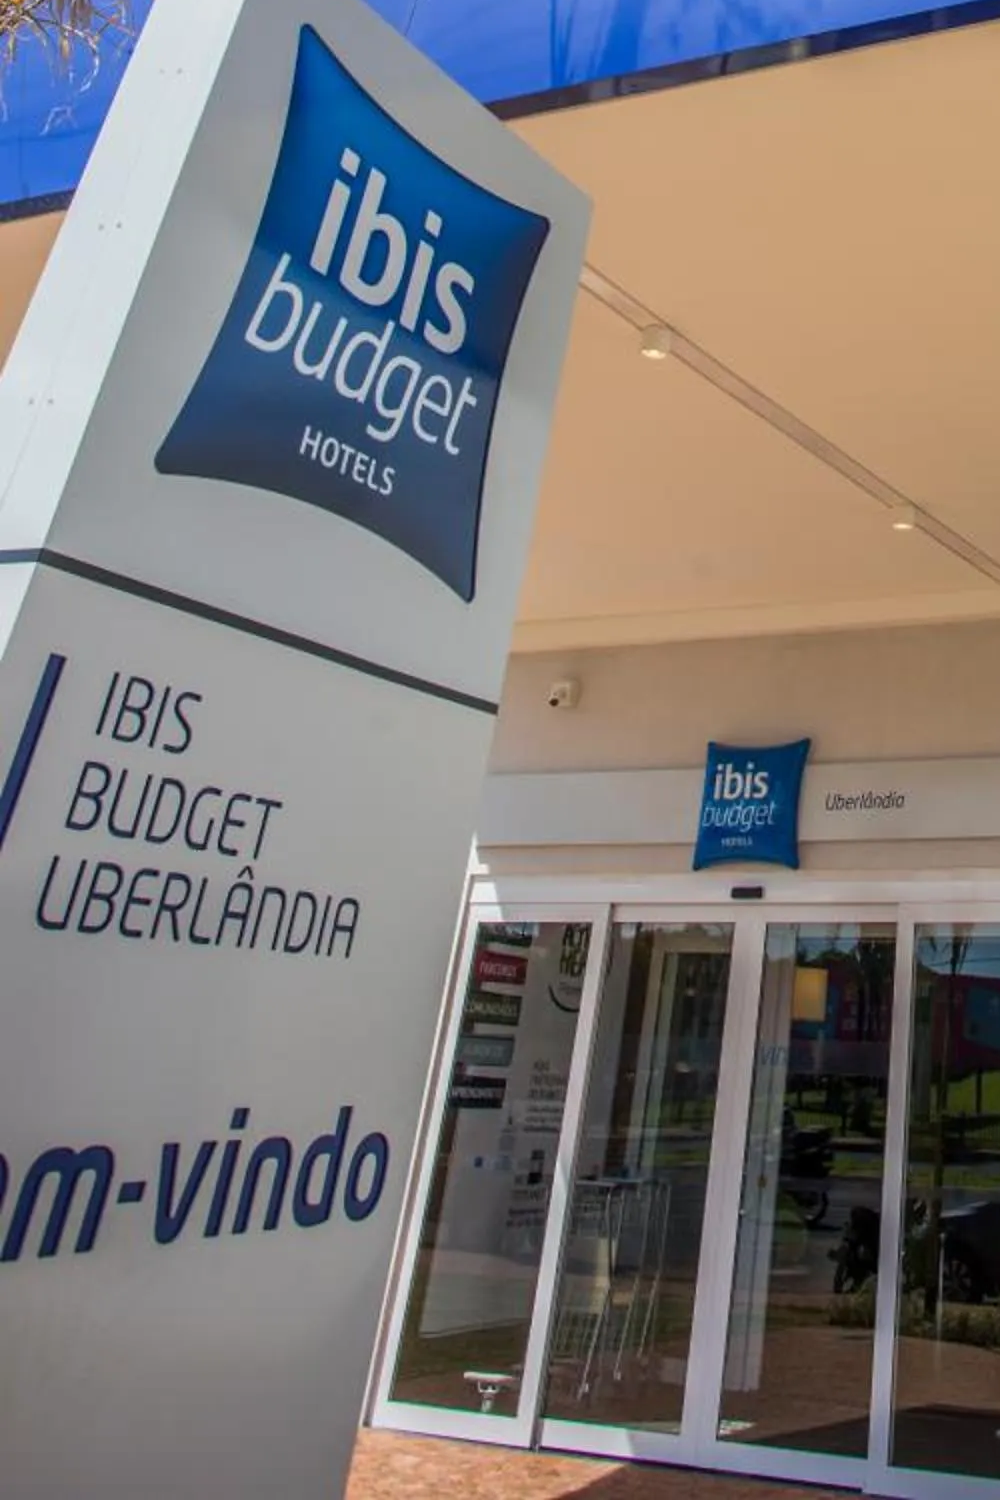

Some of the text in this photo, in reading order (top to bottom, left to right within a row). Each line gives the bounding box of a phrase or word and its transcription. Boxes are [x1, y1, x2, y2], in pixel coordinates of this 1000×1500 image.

[310, 147, 476, 354] ibis
[244, 252, 477, 455] budget
[300, 425, 396, 496] HOTELS
[95, 671, 202, 754] IBIS
[64, 761, 282, 860] BUDGET
[702, 801, 775, 832] budget
[713, 762, 769, 800] ibis
[825, 791, 906, 811] Uberlândia
[36, 855, 360, 958] UBERLÂNDIA
[0, 1106, 390, 1262] m-vindo
